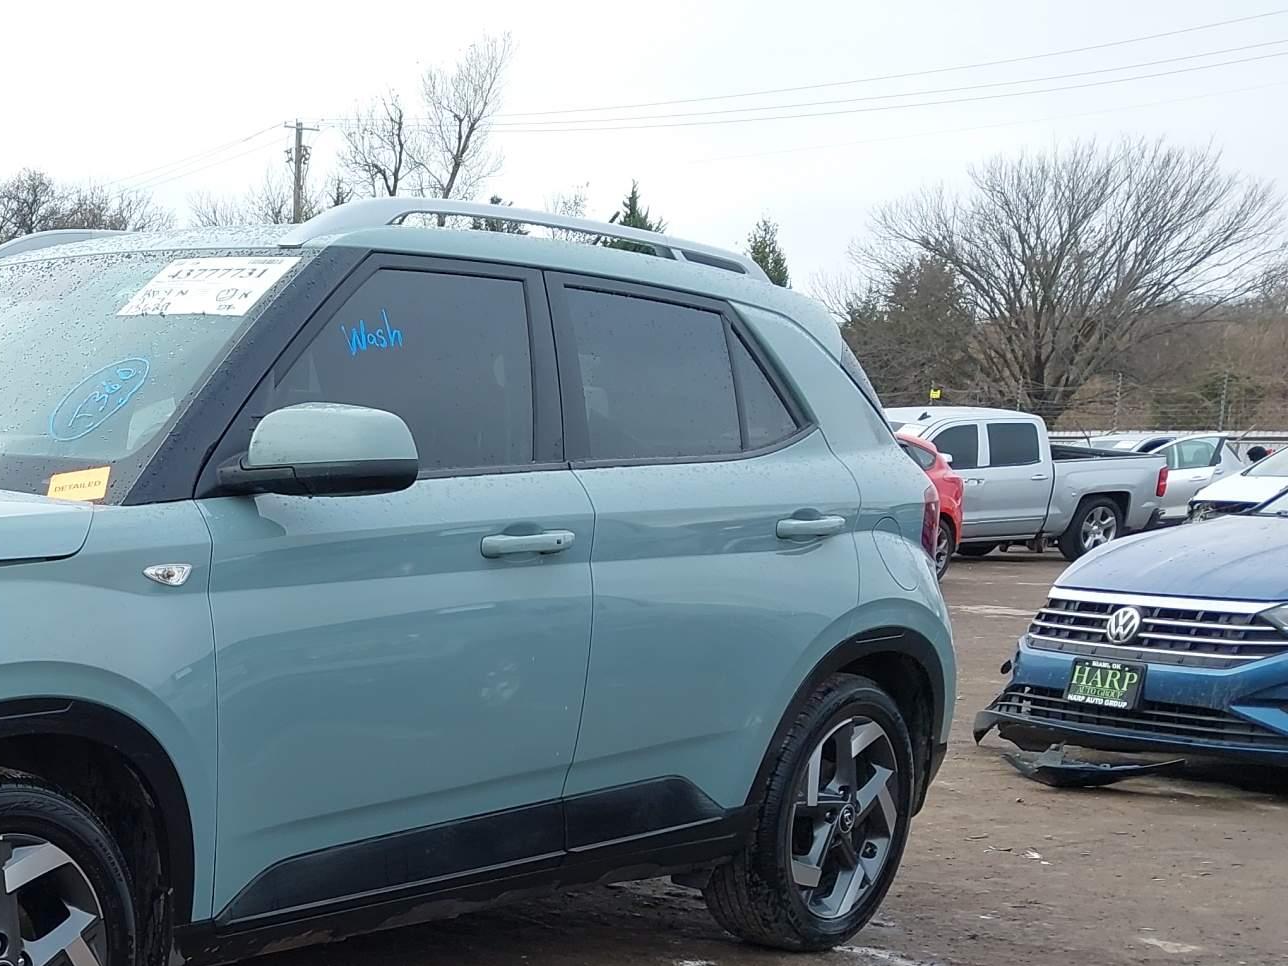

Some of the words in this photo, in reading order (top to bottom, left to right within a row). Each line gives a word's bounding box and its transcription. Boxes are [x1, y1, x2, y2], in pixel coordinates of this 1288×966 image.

[168, 268, 269, 280] 43777731
[341, 308, 403, 356] Wash
[1071, 665, 1138, 692] HARP
[1067, 693, 1086, 702] HARP
[1085, 696, 1104, 705] AUTO
[1104, 699, 1128, 708] GROUP
